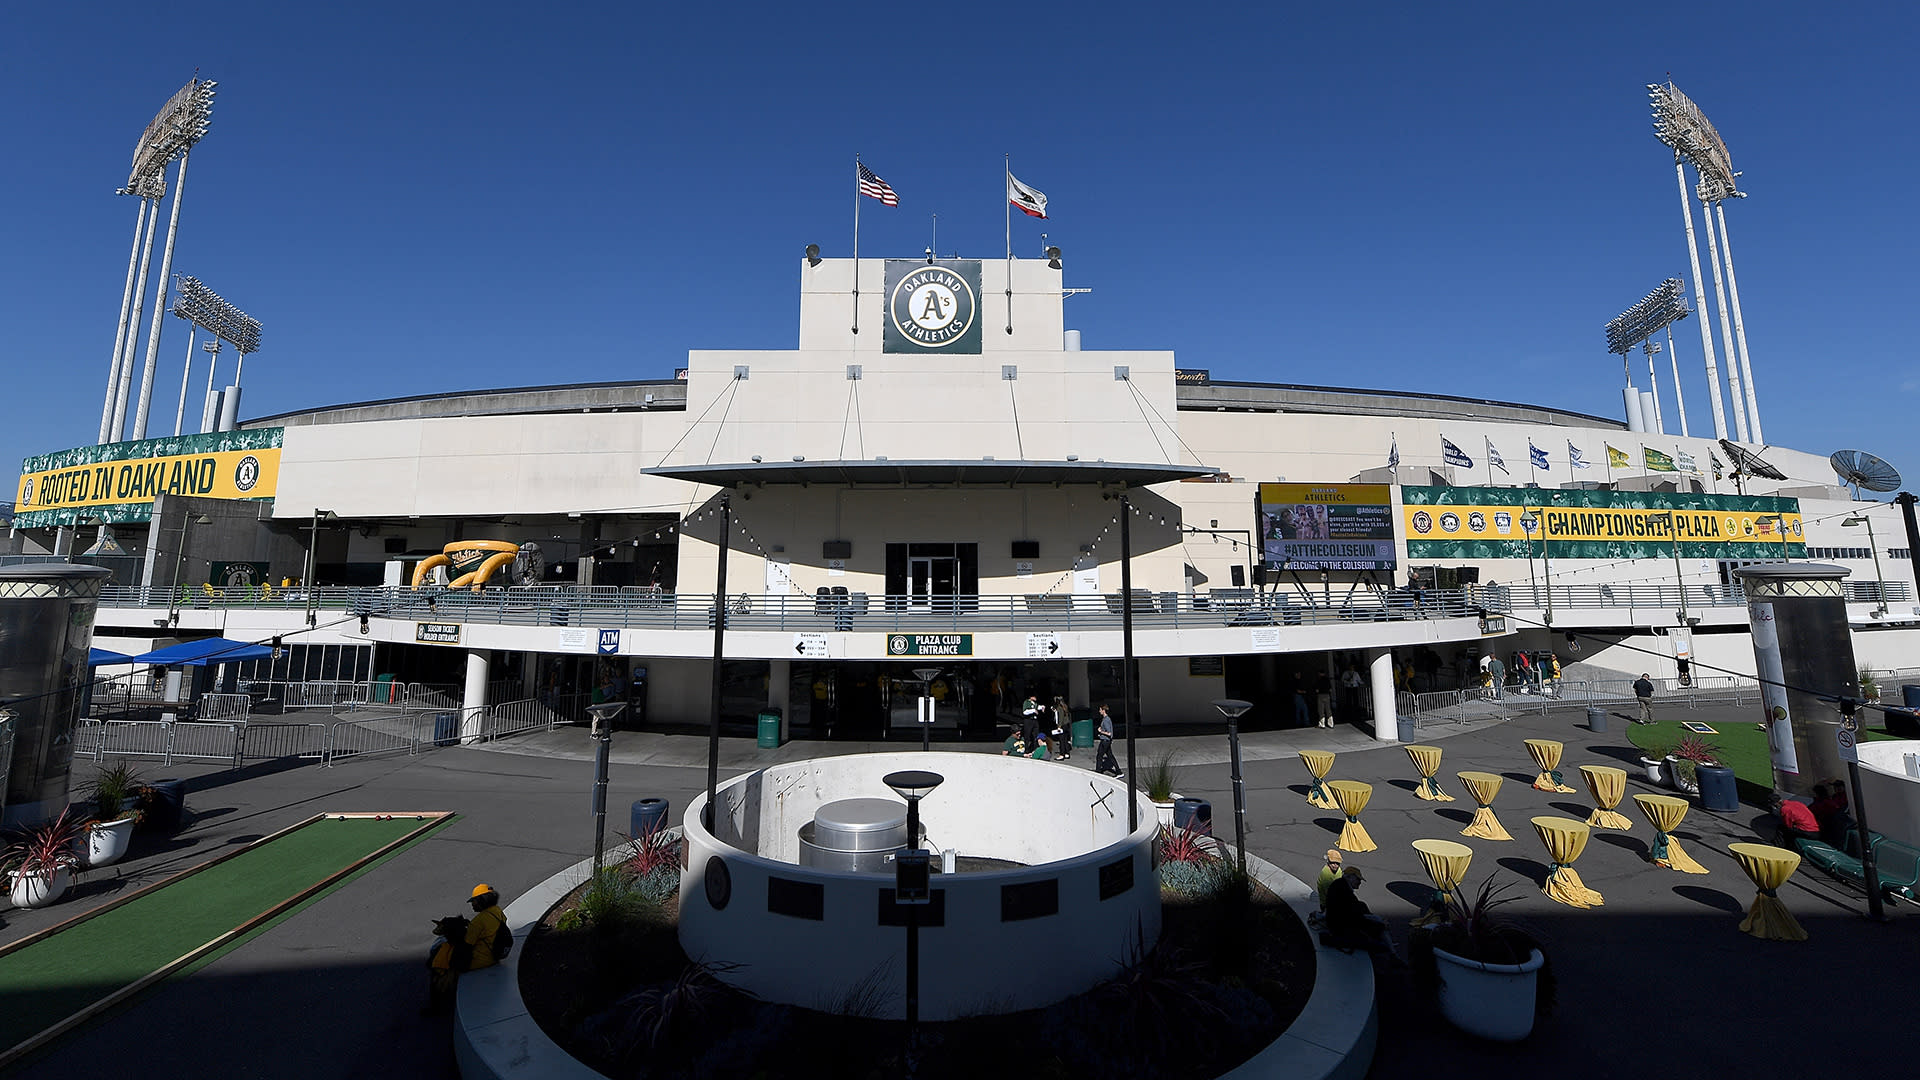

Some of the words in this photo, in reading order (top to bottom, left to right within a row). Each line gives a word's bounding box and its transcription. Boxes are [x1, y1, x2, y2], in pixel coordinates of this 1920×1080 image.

[904, 272, 962, 292] OAKLAND
[919, 289, 951, 321] A's
[901, 319, 963, 342] ATHLETICS
[38, 469, 91, 506] ROOTED
[91, 466, 115, 501] IN
[117, 458, 217, 498] OAKLAND
[1304, 494, 1346, 502] ATHLETICS
[1547, 512, 1672, 537] CHAMPIONSHIP
[1676, 515, 1720, 537] PLAZA
[1284, 543, 1376, 557] #ATTHECOLISEUM
[1288, 561, 1319, 570] WELCOME
[1329, 561, 1342, 570] THE
[1342, 562, 1376, 570] COLISEUM
[427, 625, 442, 633] SEASON
[442, 625, 456, 633] TICKET
[1496, 619, 1505, 631] CALL
[423, 633, 438, 641] HOLDER
[438, 633, 459, 642] ENTRANCE
[601, 631, 619, 645] ATM
[915, 635, 941, 645] PLAZA
[941, 635, 962, 645] CLUB
[918, 645, 959, 655] ENTRANCE
